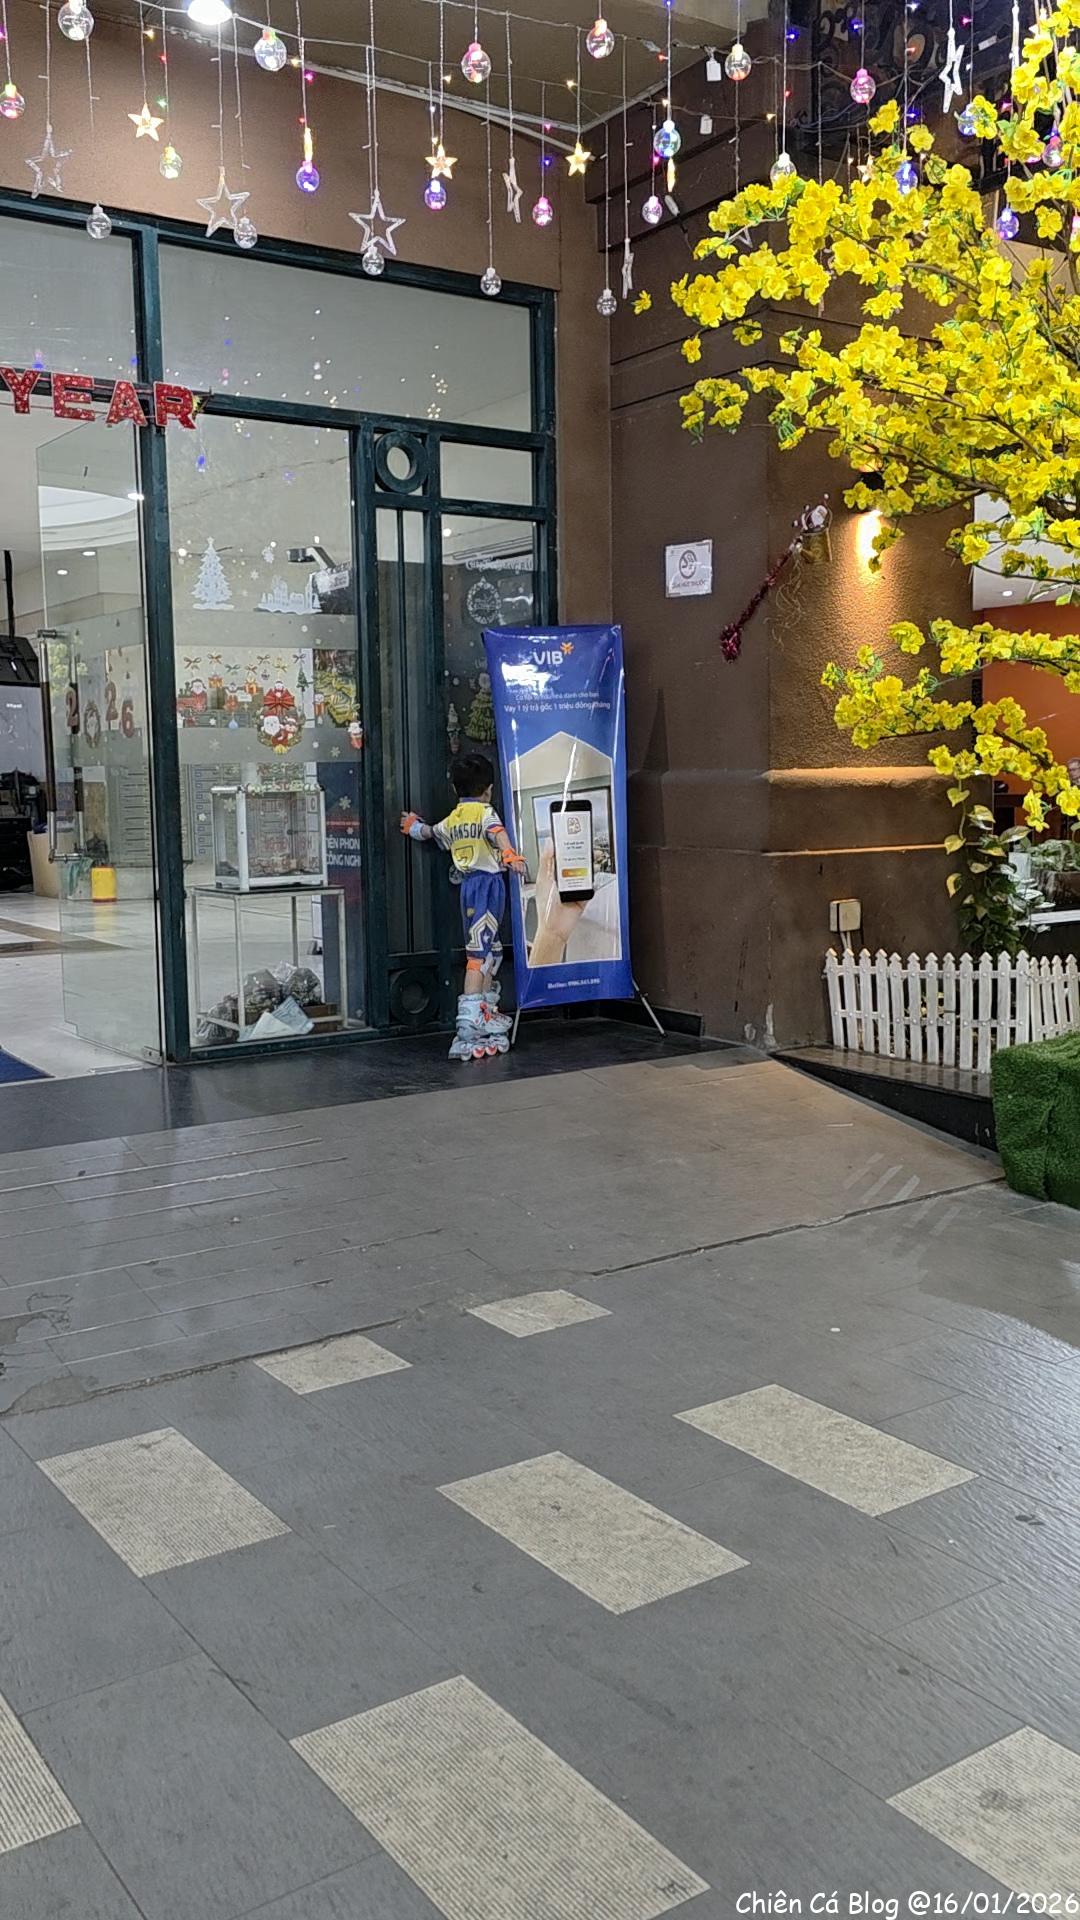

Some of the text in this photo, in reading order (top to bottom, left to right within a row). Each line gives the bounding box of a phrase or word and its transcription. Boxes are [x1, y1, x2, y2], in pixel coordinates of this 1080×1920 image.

[0, 366, 196, 430] YEAR
[533, 651, 564, 665] VIB
[339, 837, 361, 850] PHON
